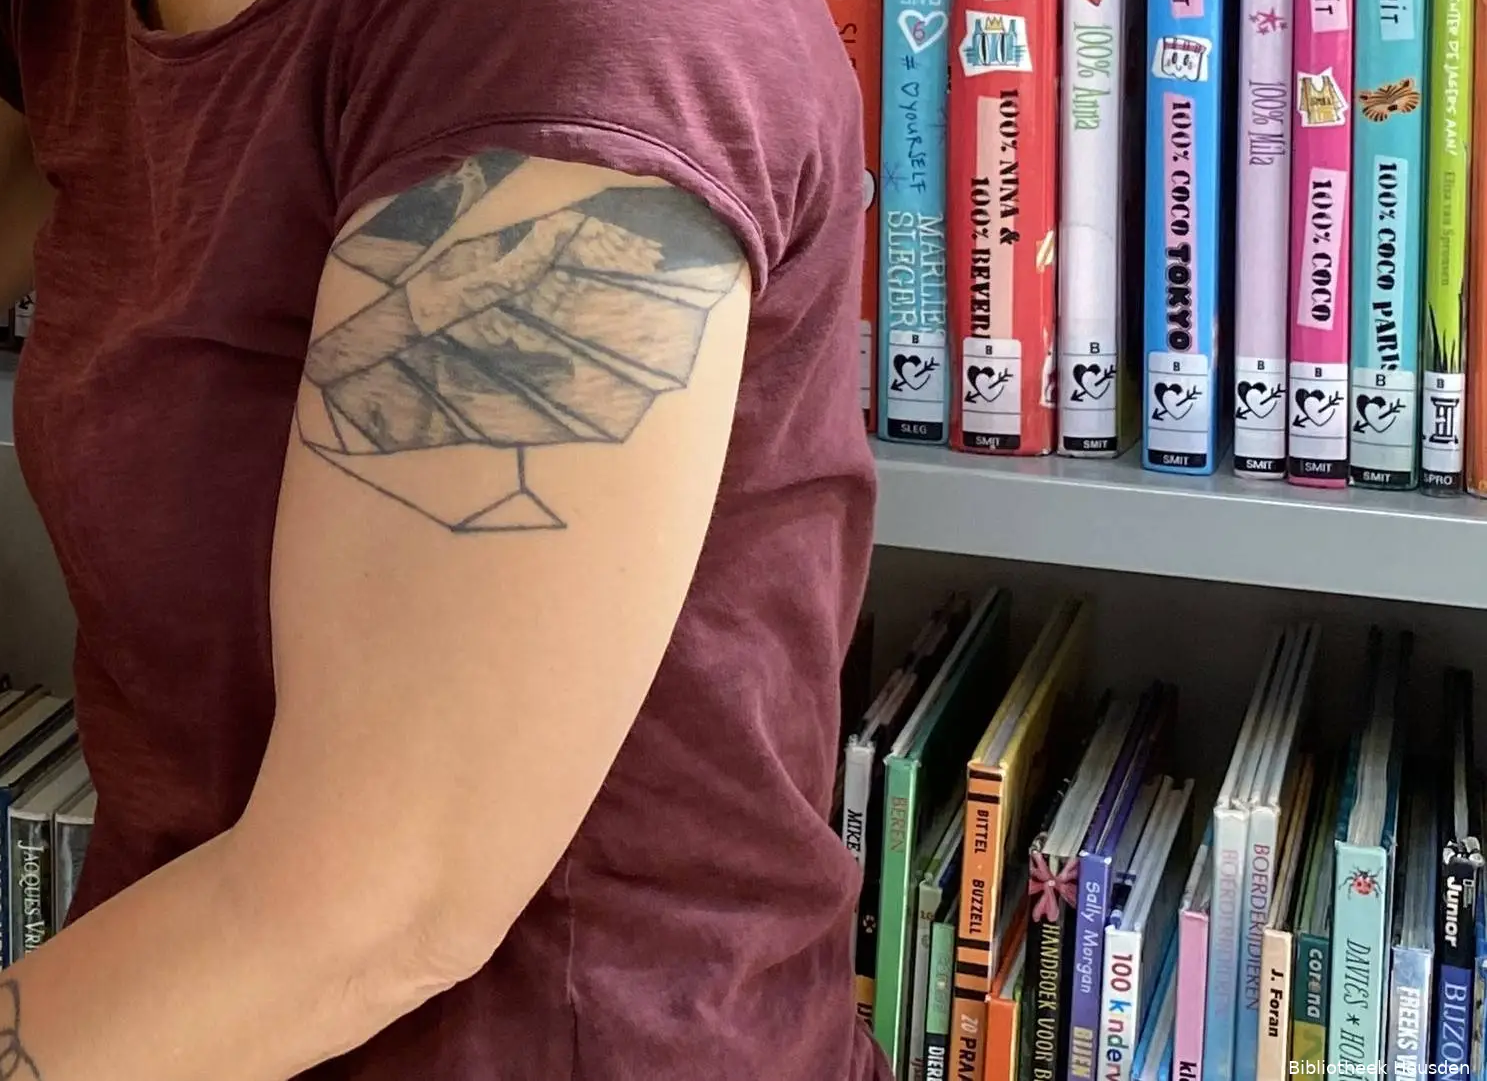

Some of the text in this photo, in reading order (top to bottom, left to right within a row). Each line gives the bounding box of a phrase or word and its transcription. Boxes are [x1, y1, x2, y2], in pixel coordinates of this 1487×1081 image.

[1445, 40, 1460, 61] DE
[1073, 22, 1114, 131] 100% Anna
[1443, 65, 1460, 114] JAGERS
[1249, 79, 1287, 166] 100% Mila
[1444, 119, 1459, 156] AAN!
[998, 89, 1021, 246] 100% NINA &
[970, 176, 991, 240] 100%
[1376, 162, 1399, 220] 100%
[1165, 101, 1193, 352] 100% COCO TOKYO
[1442, 204, 1452, 224] van
[1310, 179, 1333, 322] 100% COCO
[1376, 227, 1397, 290] COCO
[911, 334, 920, 344] B
[985, 344, 993, 356] B
[1089, 342, 1101, 354] B
[1173, 362, 1181, 372] B
[1257, 360, 1265, 371] B
[1314, 367, 1323, 377] B
[1375, 374, 1387, 387] B
[1436, 378, 1445, 389] B
[900, 423, 928, 435] SLEG
[975, 436, 1001, 448] SMIT
[1083, 439, 1108, 450] SMIT
[1162, 454, 1190, 466] SMIT
[1246, 460, 1273, 470] SMIT
[1304, 461, 1332, 472] SMIT
[1362, 472, 1391, 483] SMIT
[1423, 474, 1453, 486] SPRO
[846, 809, 863, 852] MIKE
[890, 797, 908, 851] BEREN
[17, 840, 45, 916] JACQUES
[968, 809, 989, 935] BITTEL BUZZELL
[1443, 875, 1462, 947] Junior
[1076, 881, 1101, 994] Sally Morgan
[1038, 923, 1061, 1010] HANDBOEK
[1111, 953, 1133, 993] 100
[1343, 939, 1371, 1009] DAVIES
[1268, 968, 1282, 1038] J. Foran
[1396, 986, 1419, 1050] FREEKS
[1035, 1017, 1056, 1062] VOOR
[1072, 1026, 1093, 1080] BIJEN
